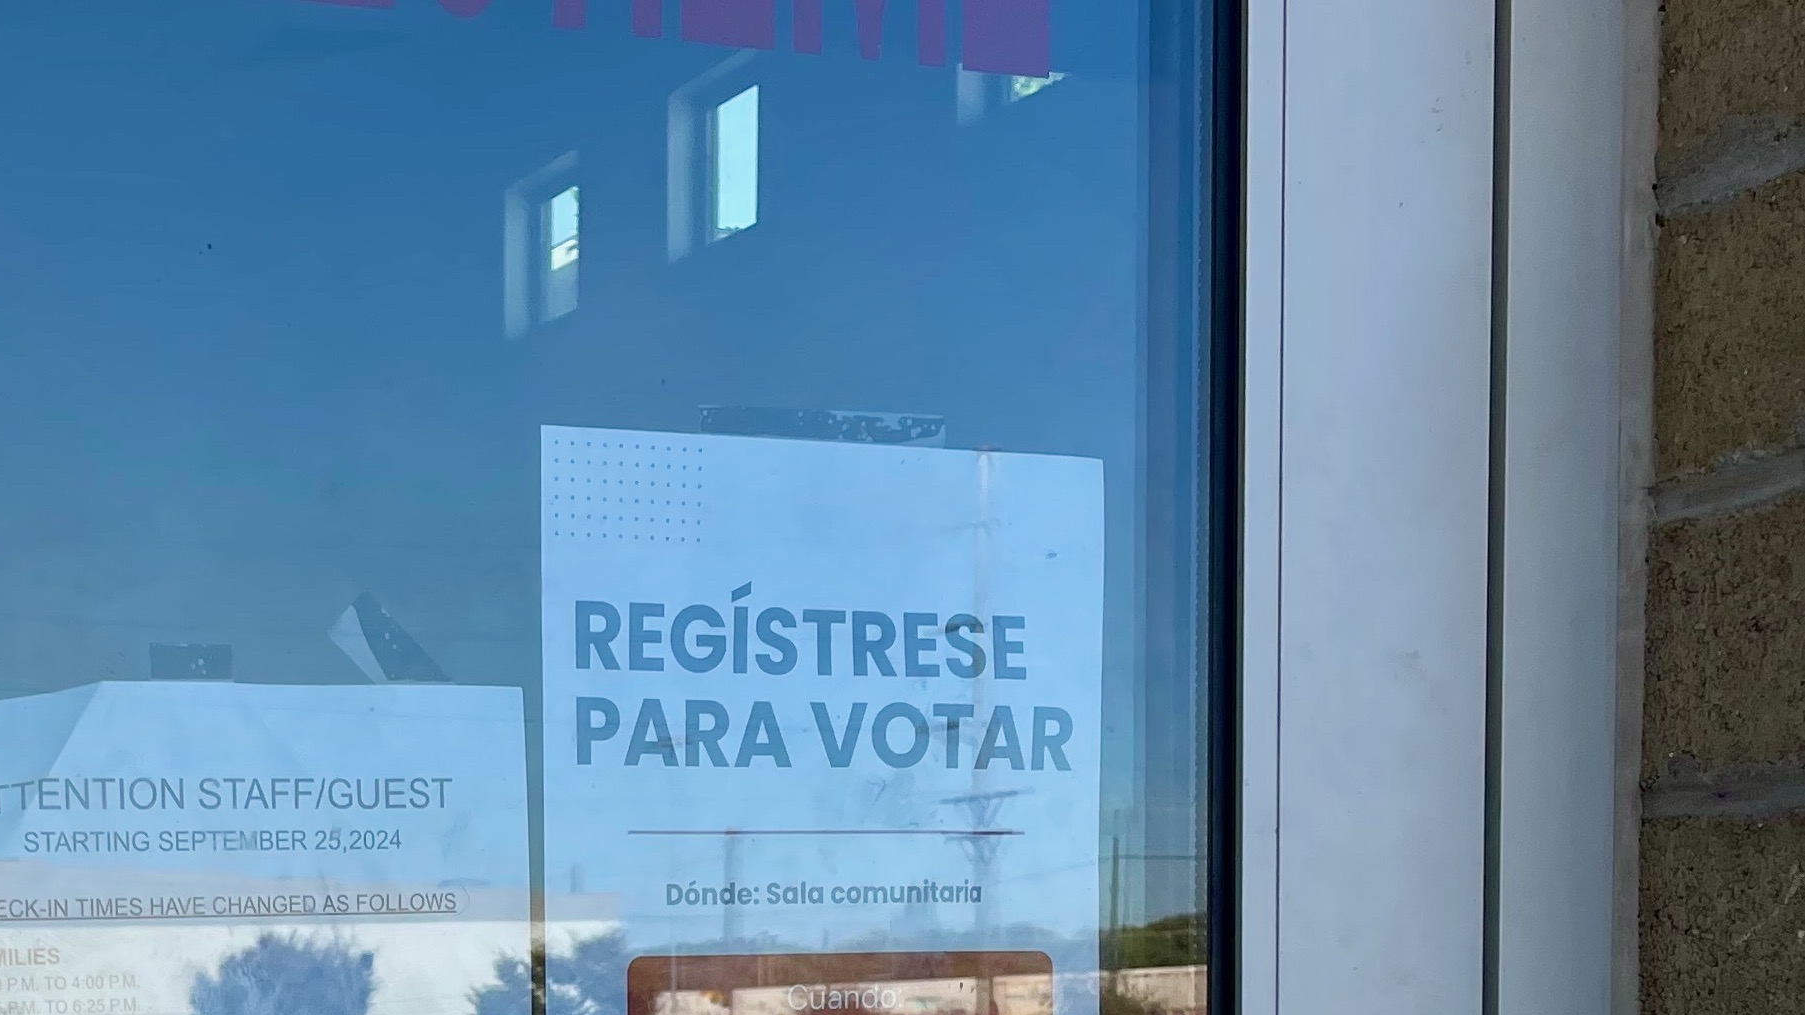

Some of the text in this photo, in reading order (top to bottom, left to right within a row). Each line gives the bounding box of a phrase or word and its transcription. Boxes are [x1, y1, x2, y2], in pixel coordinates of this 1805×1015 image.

[574, 581, 1027, 680] REGÍSTRESE
[576, 697, 1073, 772] PARA VOTAR
[199, 778, 452, 809] STAFF/GUEST
[24, 829, 402, 853] STARTING SEPTEMBER 25,2024
[75, 897, 143, 917] TIMES
[150, 897, 205, 916] HAVE
[213, 895, 316, 914] CHANGED
[323, 894, 349, 912] AS
[356, 892, 456, 912] FOLLOWS
[666, 879, 982, 905] Dónde: Sala comunitaria
[45, 976, 67, 990] TO
[45, 1000, 67, 1014] TO
